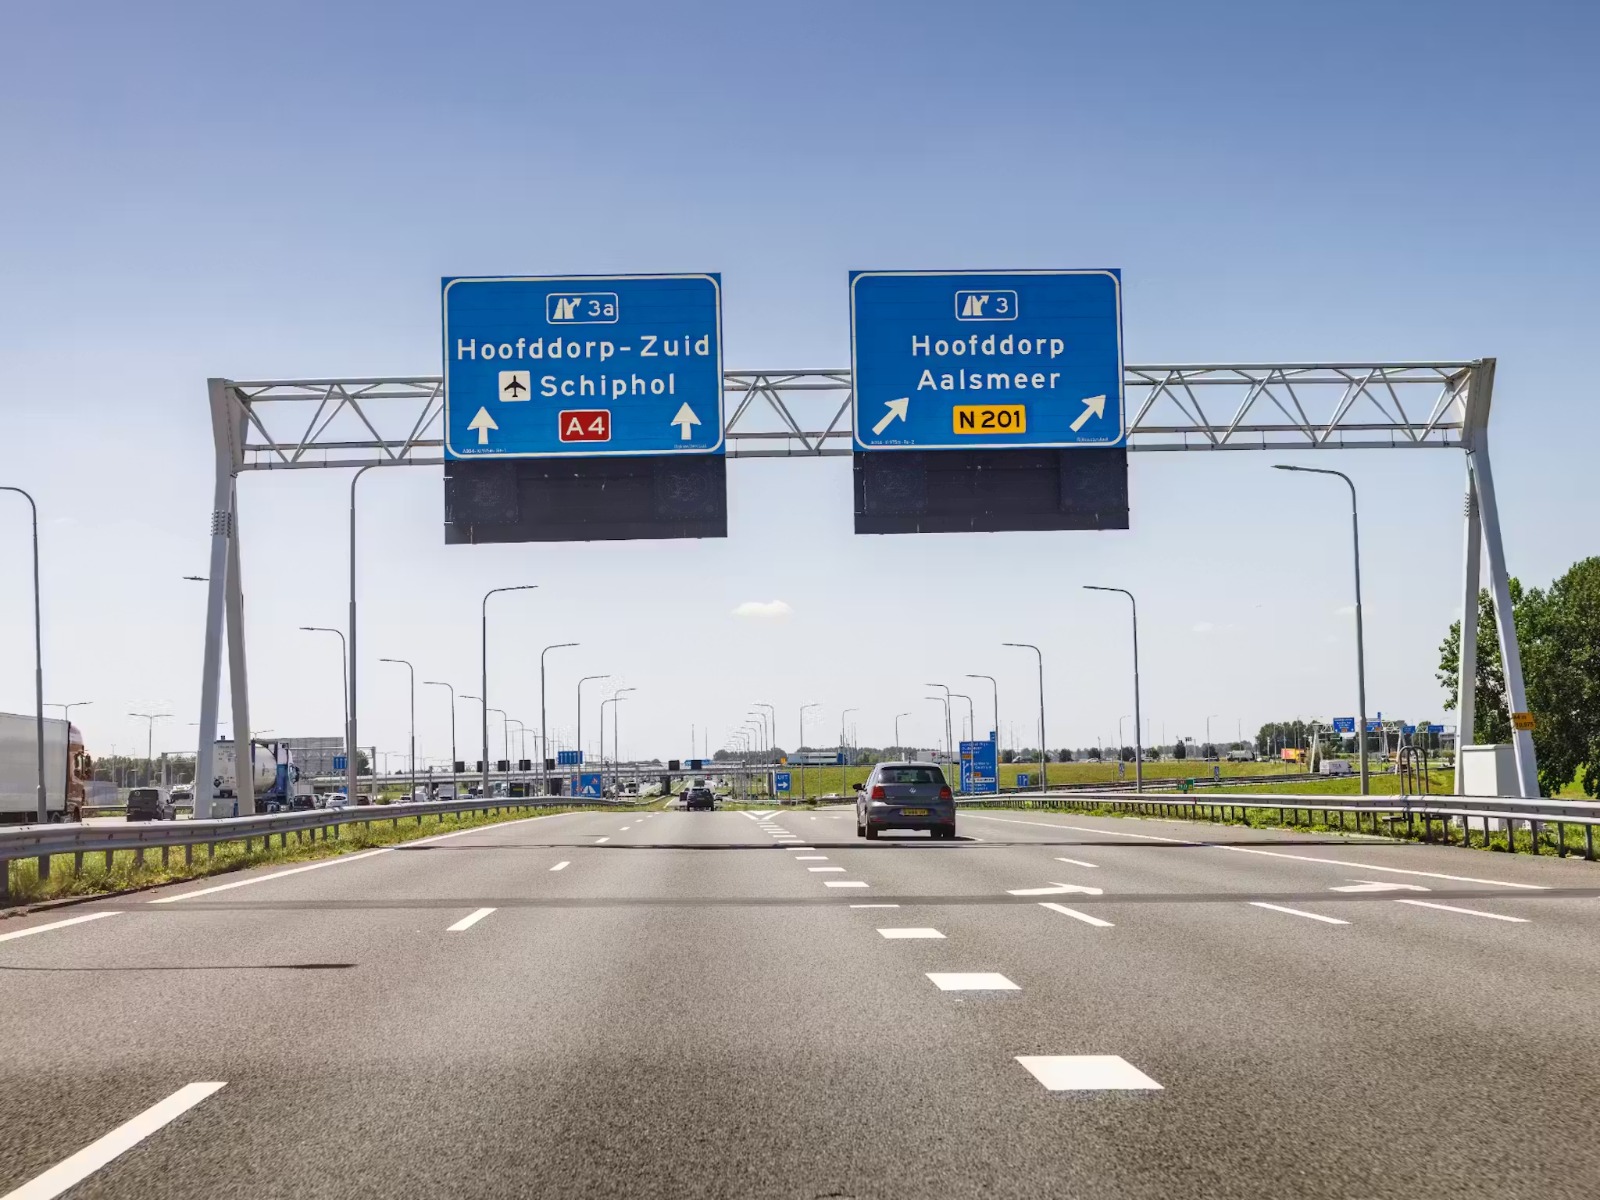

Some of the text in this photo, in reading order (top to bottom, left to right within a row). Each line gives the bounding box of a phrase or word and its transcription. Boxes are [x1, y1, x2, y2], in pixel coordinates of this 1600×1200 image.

[587, 300, 614, 317] 3a
[996, 298, 1008, 313] 3
[912, 334, 1065, 358] Hoofddorp
[540, 373, 675, 400] Schiphol
[917, 369, 1060, 391] Aalsmeer
[565, 416, 605, 436] A4
